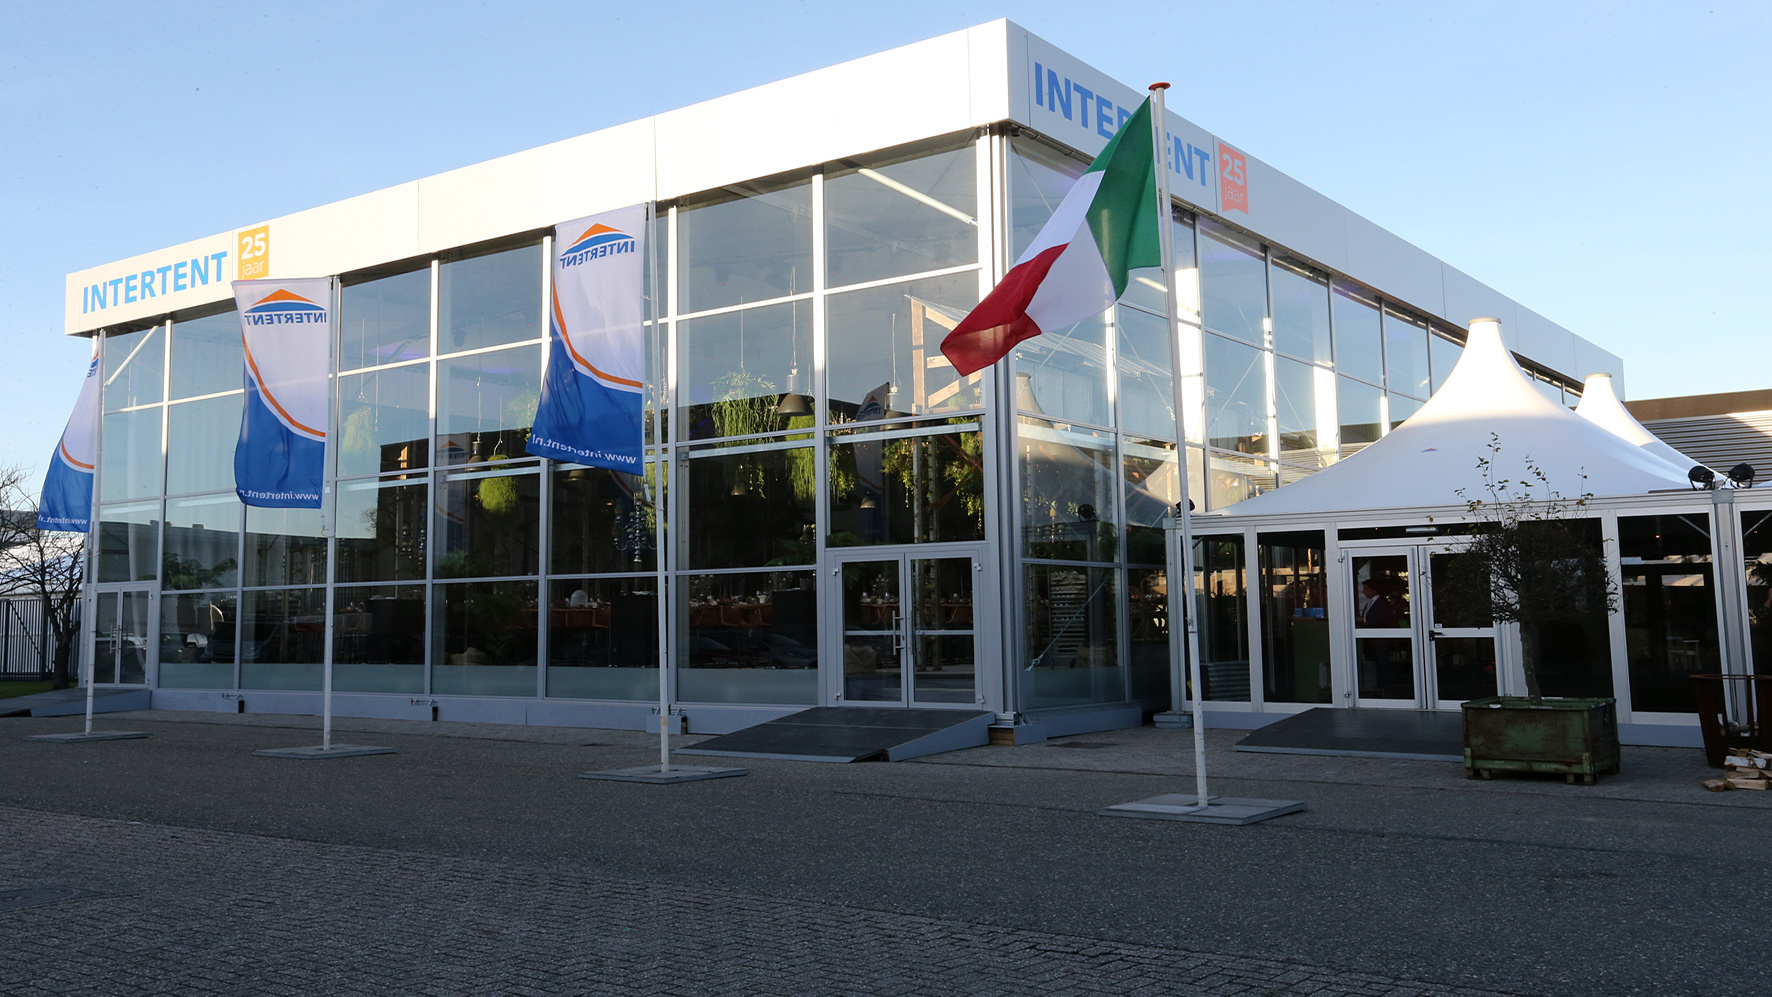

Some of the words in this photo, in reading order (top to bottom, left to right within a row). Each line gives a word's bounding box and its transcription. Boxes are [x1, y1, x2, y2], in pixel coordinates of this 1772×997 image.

[1034, 61, 1210, 187] INTENT
[1222, 153, 1244, 186] 25
[1224, 179, 1245, 206] jaar
[241, 232, 266, 260] 25
[83, 250, 228, 314] INTERTENT
[241, 260, 265, 280] jaar
